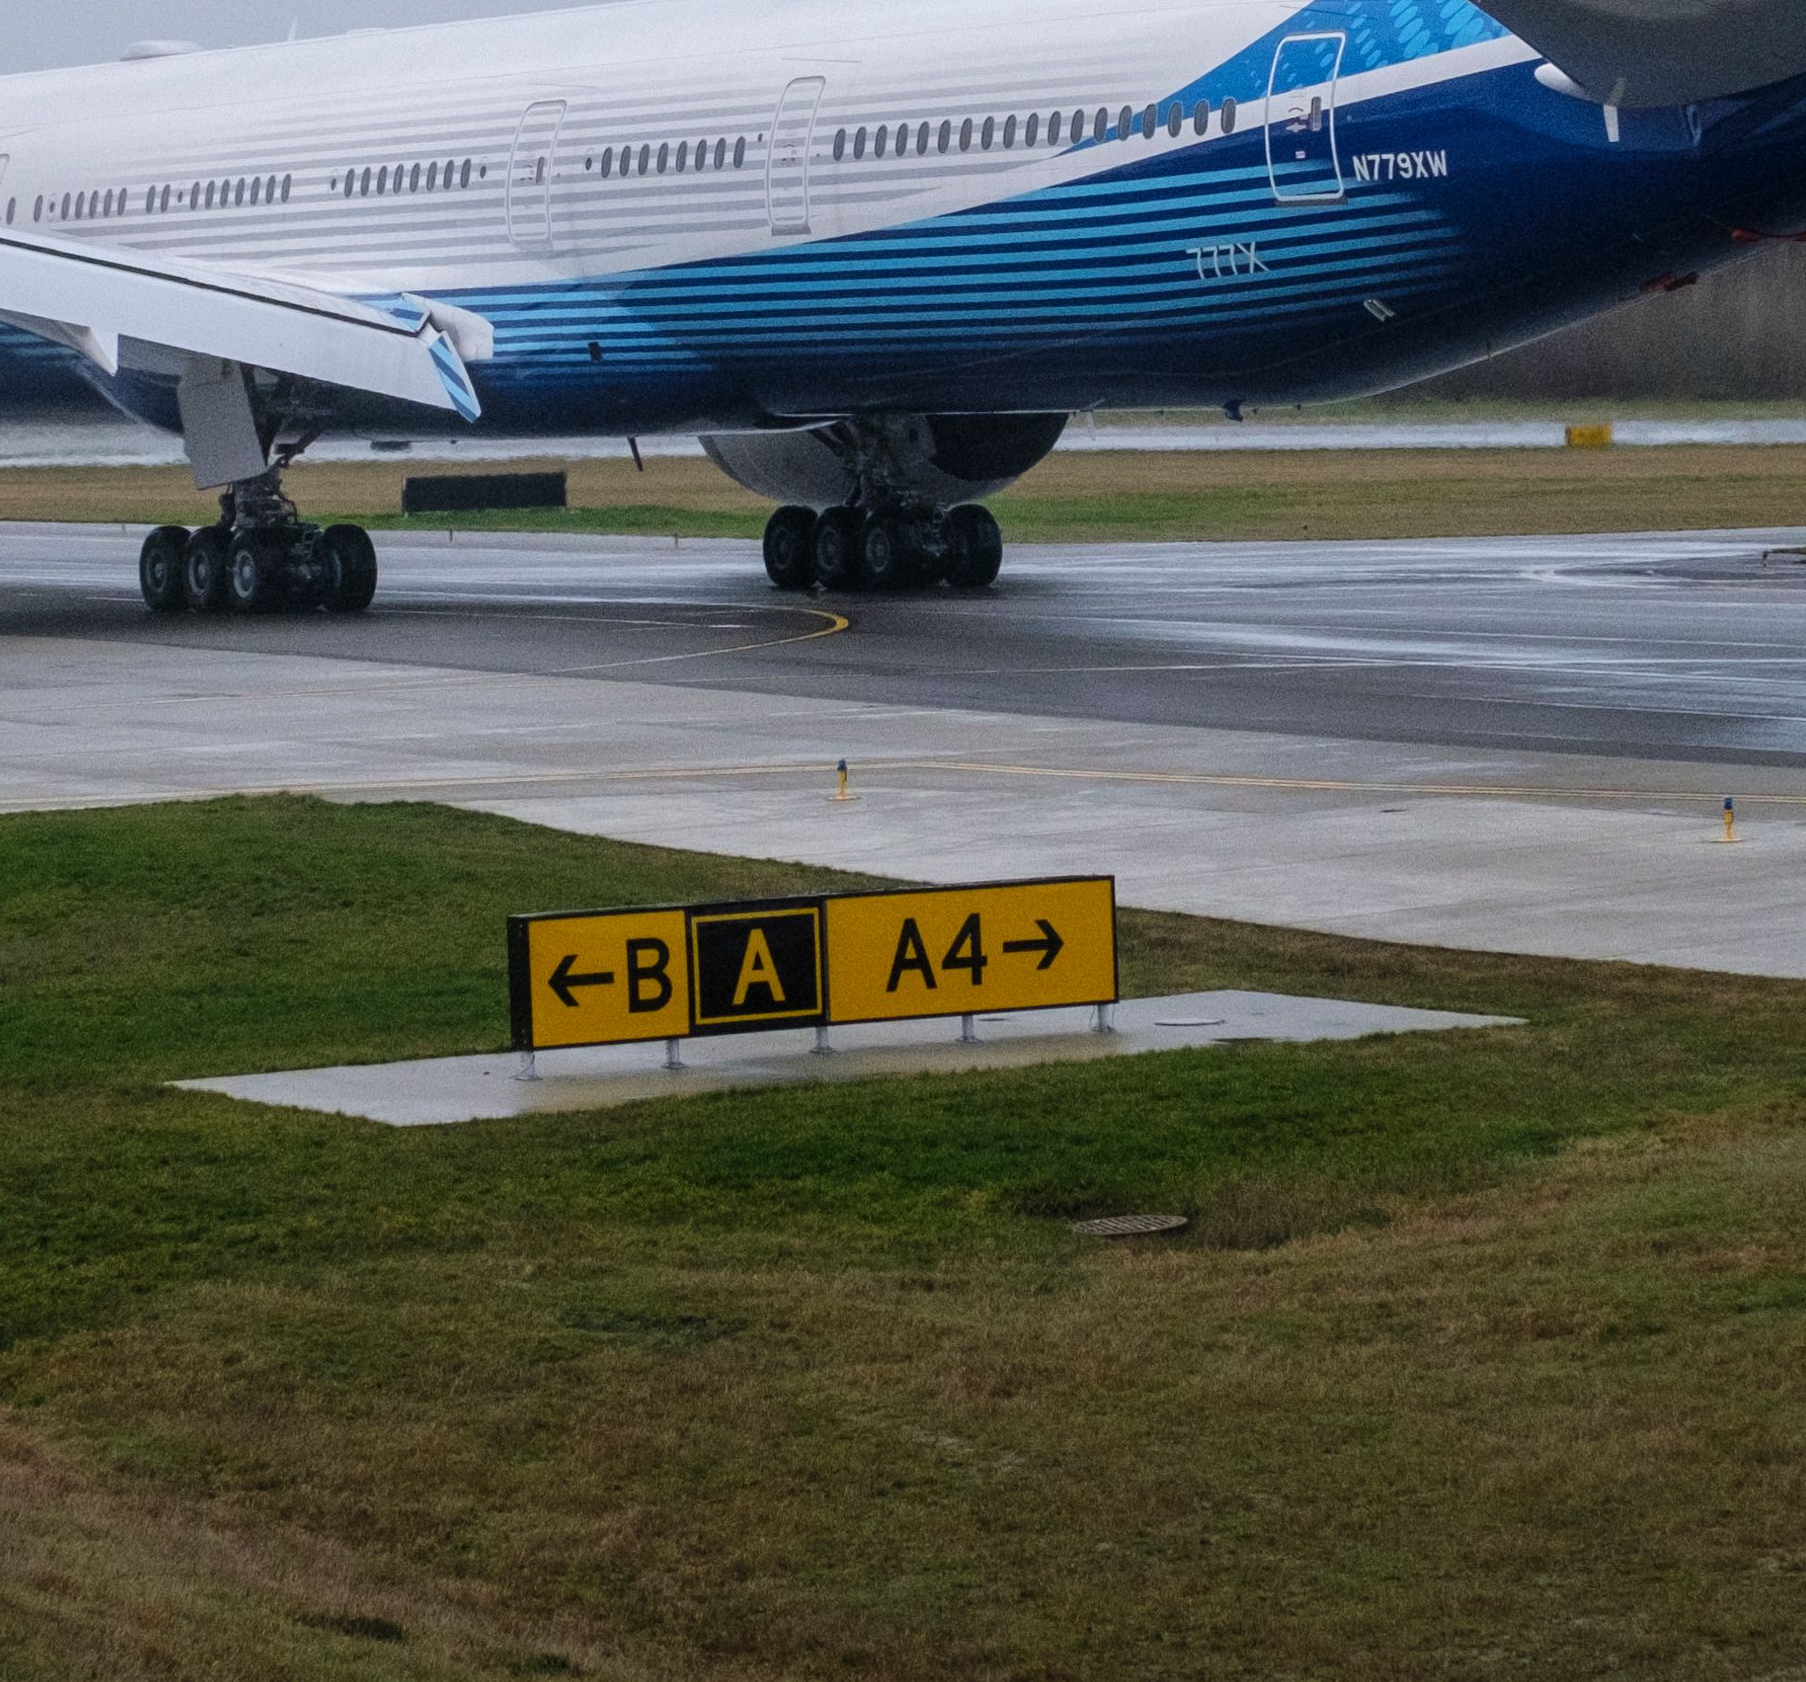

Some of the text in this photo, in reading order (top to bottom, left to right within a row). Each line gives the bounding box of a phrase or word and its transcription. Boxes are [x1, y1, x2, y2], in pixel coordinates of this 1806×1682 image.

[1352, 150, 1447, 182] N779XW
[1185, 240, 1271, 281] 777X
[626, 912, 989, 1014] B A A4
